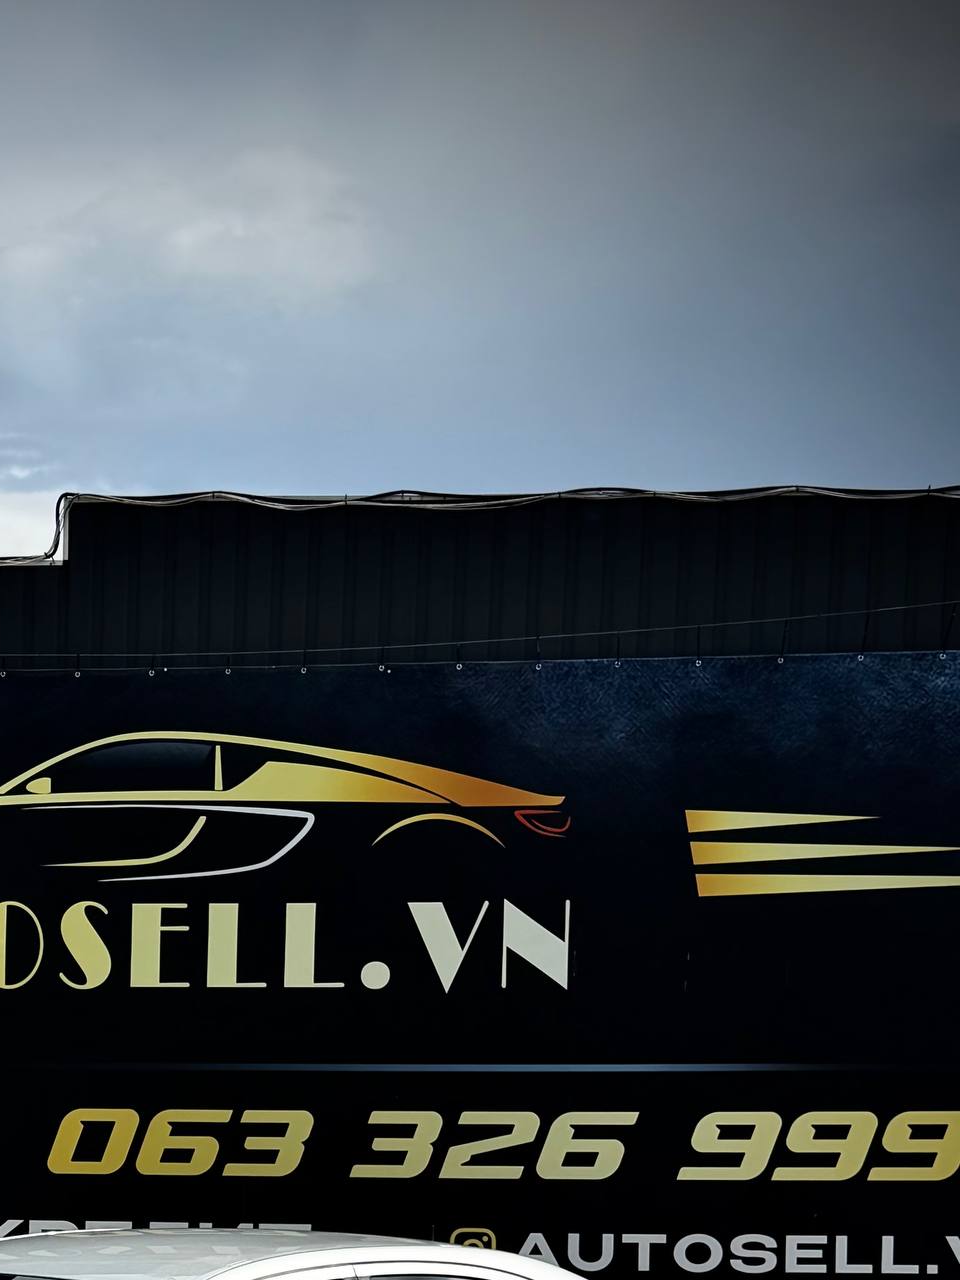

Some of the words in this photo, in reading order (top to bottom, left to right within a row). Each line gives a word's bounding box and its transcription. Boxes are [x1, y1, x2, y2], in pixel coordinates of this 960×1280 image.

[46, 1108, 315, 1177] 063
[349, 1110, 640, 1180] 326
[676, 1110, 960, 1181] 999
